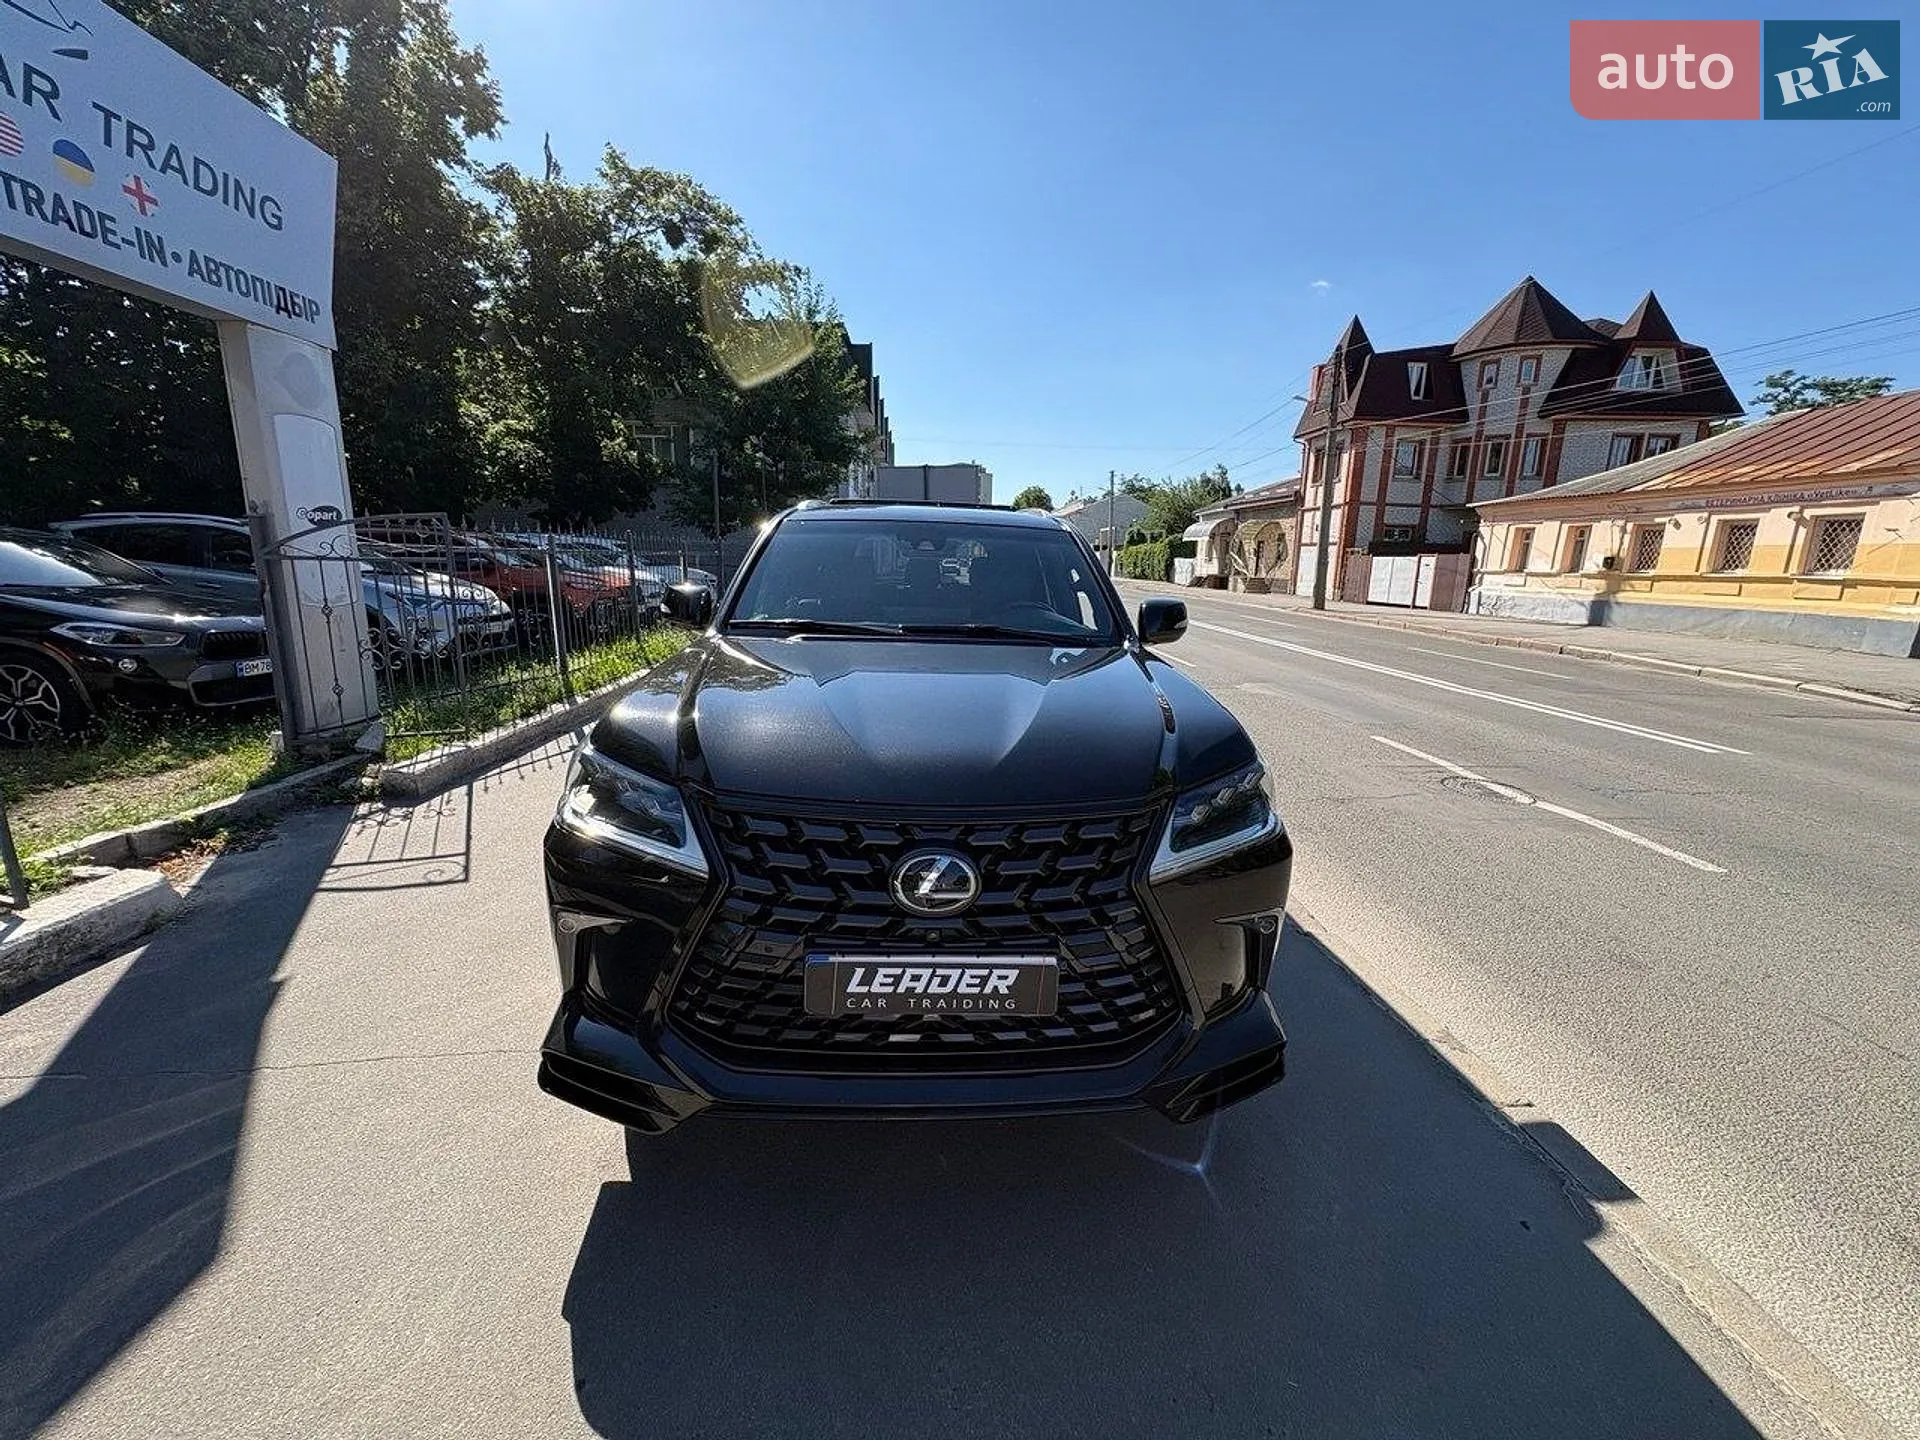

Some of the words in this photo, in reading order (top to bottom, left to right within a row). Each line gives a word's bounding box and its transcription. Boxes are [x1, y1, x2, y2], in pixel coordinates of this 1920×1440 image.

[92, 101, 283, 231] TRADING
[0, 170, 168, 268] TRADE-IN
[188, 249, 321, 324] АВТОПІДБІР
[296, 507, 338, 522] Copart
[846, 967, 1020, 995] LEADER
[846, 998, 888, 1009] CAR
[908, 998, 1017, 1009] TRAIDING
